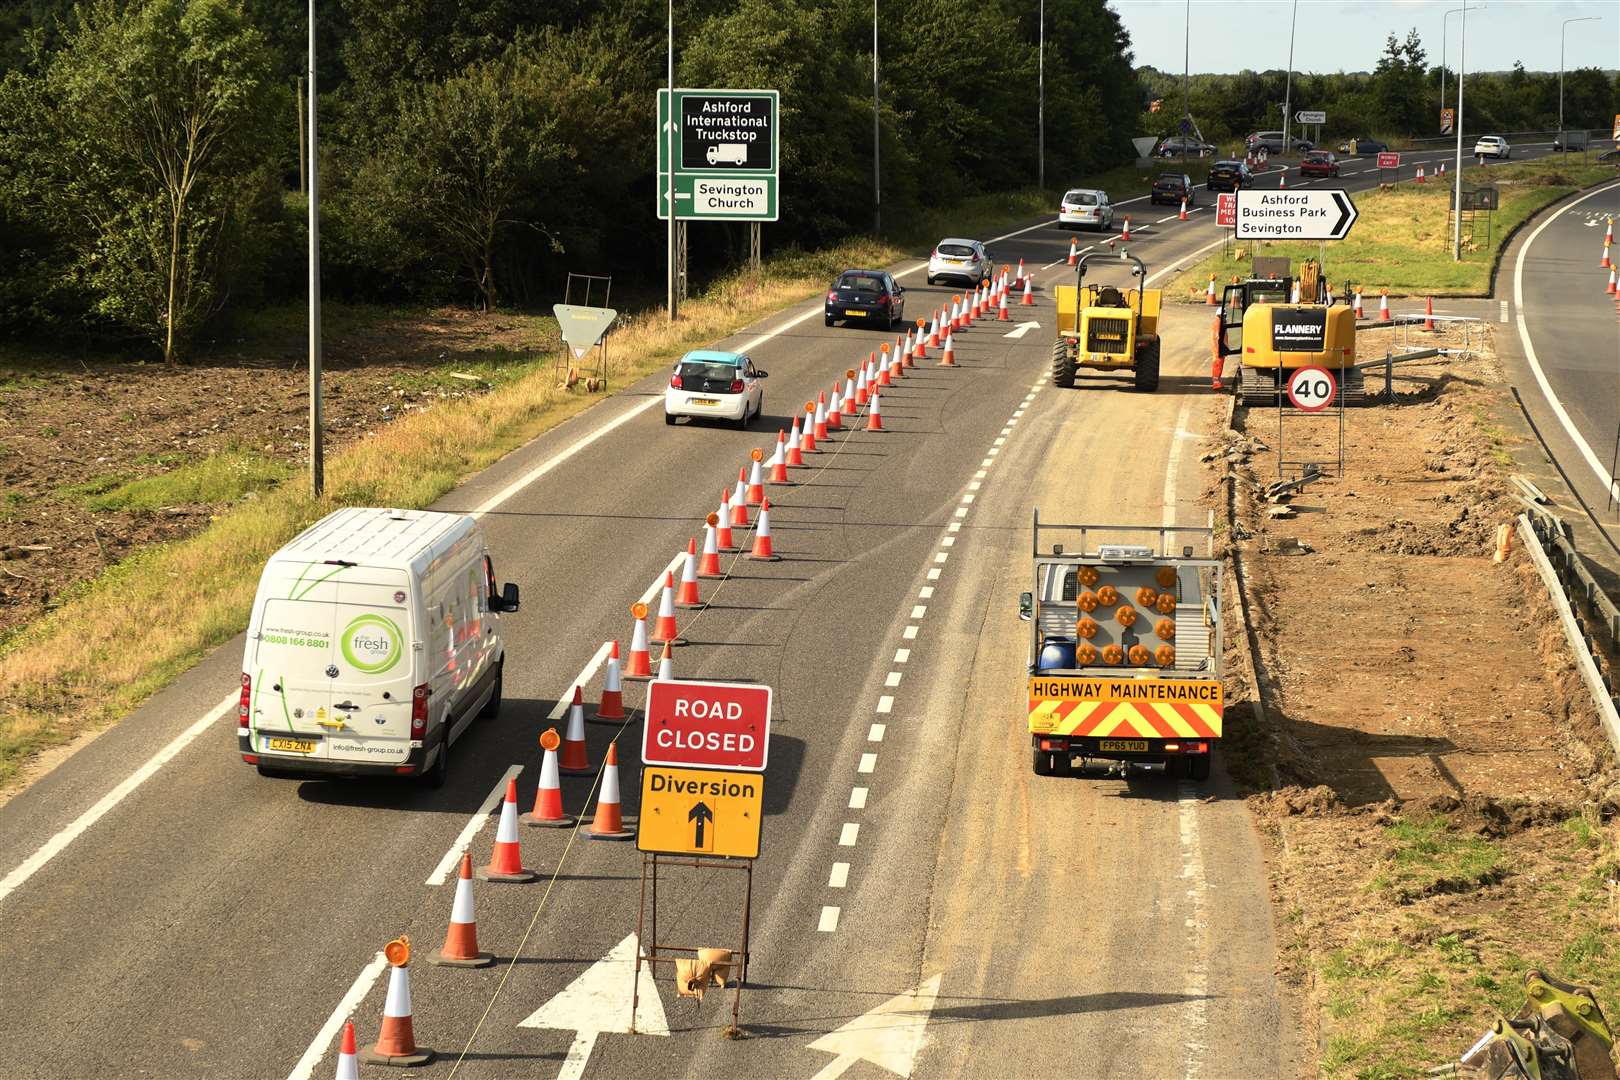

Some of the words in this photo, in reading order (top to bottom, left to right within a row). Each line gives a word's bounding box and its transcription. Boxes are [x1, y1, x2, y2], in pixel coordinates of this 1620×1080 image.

[702, 101, 751, 113] Ashford
[687, 114, 768, 127] International
[695, 128, 757, 142] Truckstop
[699, 183, 763, 196] Sevington
[708, 197, 754, 208] Church
[1261, 194, 1309, 205] Ashford
[1242, 207, 1295, 217] Business
[1300, 207, 1327, 217] Park
[1242, 223, 1302, 235] Sevington
[1275, 324, 1322, 334] FLANNERY
[1294, 379, 1330, 398] 40
[264, 634, 288, 645] 0808
[307, 638, 329, 648] 8801
[354, 636, 388, 649] fresh
[1033, 682, 1102, 697] HIGHWAY
[1110, 684, 1218, 700] MAINTENANCE
[674, 699, 743, 720] ROAD
[656, 729, 755, 752] CLOSED
[1103, 741, 1126, 750] FP65
[650, 774, 755, 798] Diversion
